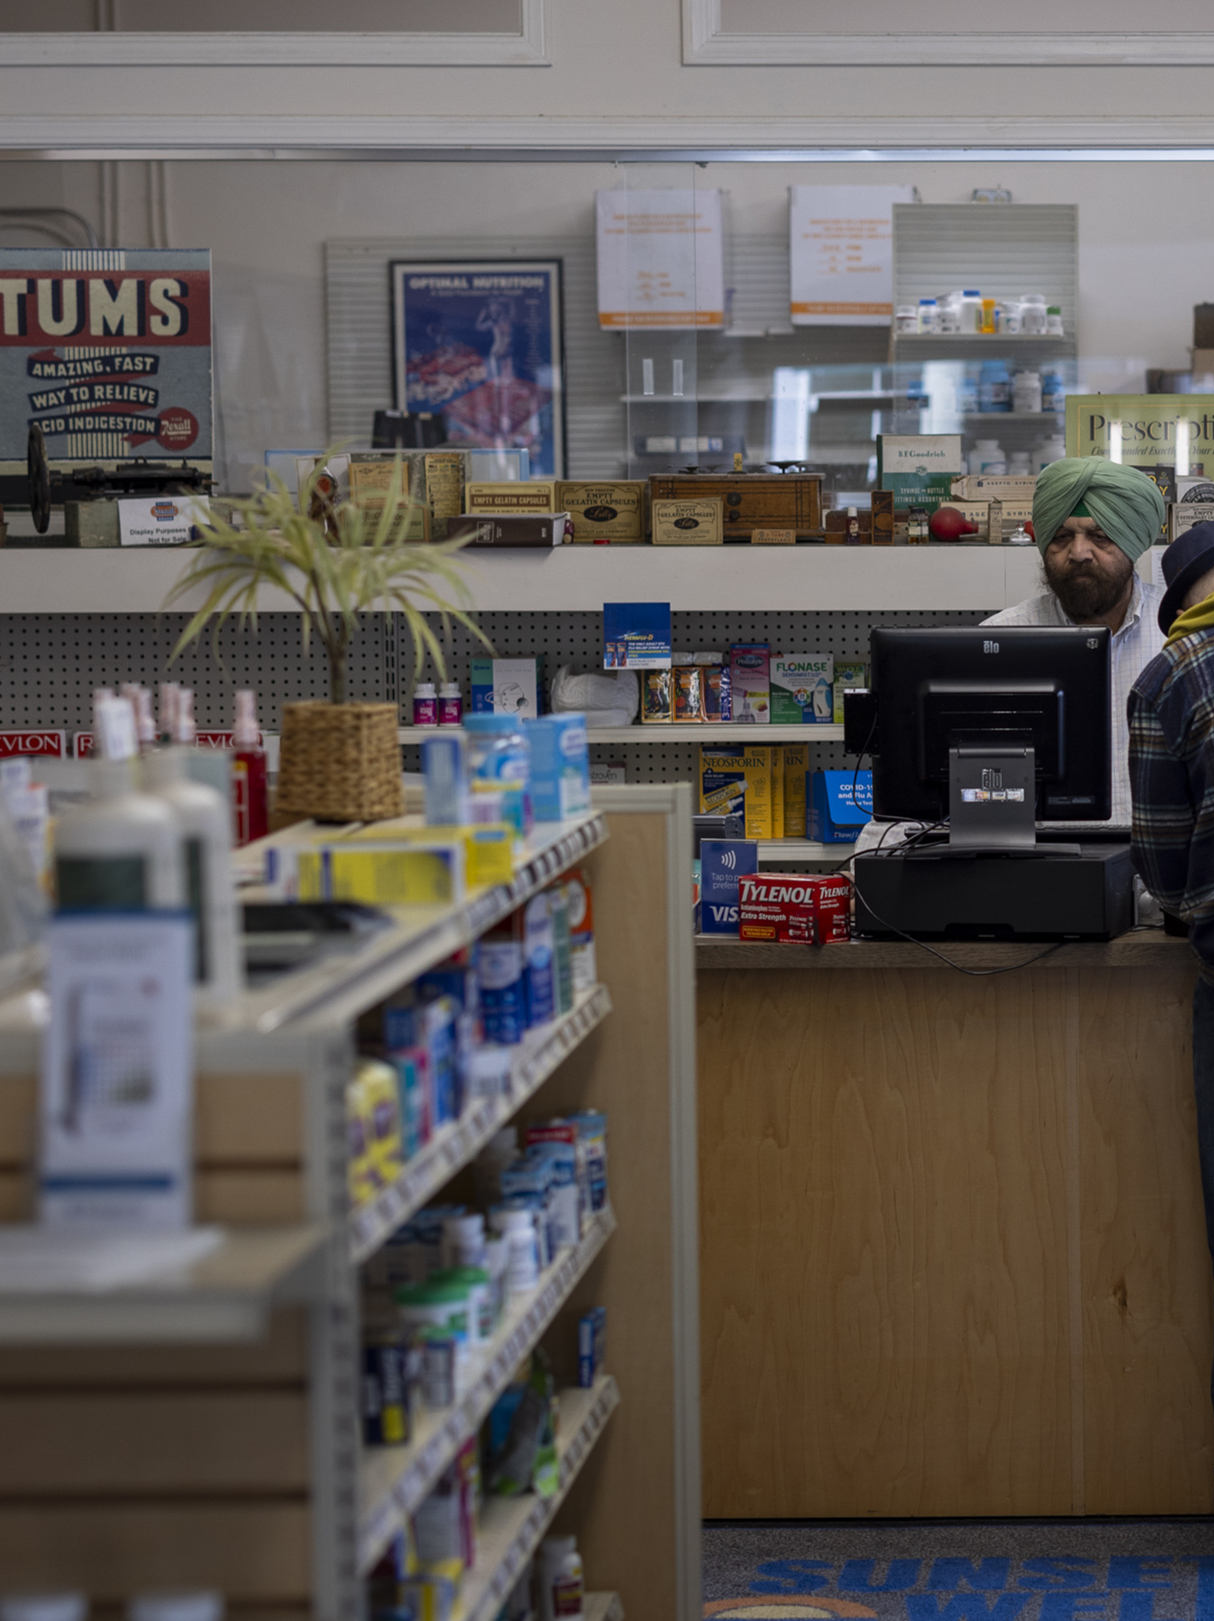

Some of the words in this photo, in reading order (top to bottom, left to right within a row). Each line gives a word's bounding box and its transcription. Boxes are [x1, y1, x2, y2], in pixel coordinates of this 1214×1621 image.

[409, 276, 469, 290] OPTIMAL
[472, 276, 544, 289] NUTRITION
[0, 278, 189, 337] TUMS
[32, 359, 111, 376] AMAZING,
[114, 356, 155, 372] FAST
[31, 389, 67, 409] WAY
[69, 386, 89, 400] TO
[94, 385, 156, 404] RELIEVE
[33, 418, 65, 433] ACID
[69, 416, 155, 433] INDIGESTION
[161, 419, 192, 436] Rexall
[473, 496, 493, 505] EMPTY
[493, 496, 519, 505] GELATIN
[520, 496, 547, 505] CAPSULES
[600, 498, 636, 506] CAPSULES
[129, 528, 154, 536] Display
[776, 662, 827, 672] FLONASE
[0, 735, 59, 750] VLON
[702, 757, 765, 768] NEOSPORIN
[711, 873, 725, 881] Tap
[712, 882, 740, 890] preferr
[740, 880, 814, 904] TYLENOL
[819, 886, 850, 899] TYLENOL
[709, 905, 740, 922] VIS
[741, 912, 757, 920] Extra
[758, 913, 787, 922] Strength
